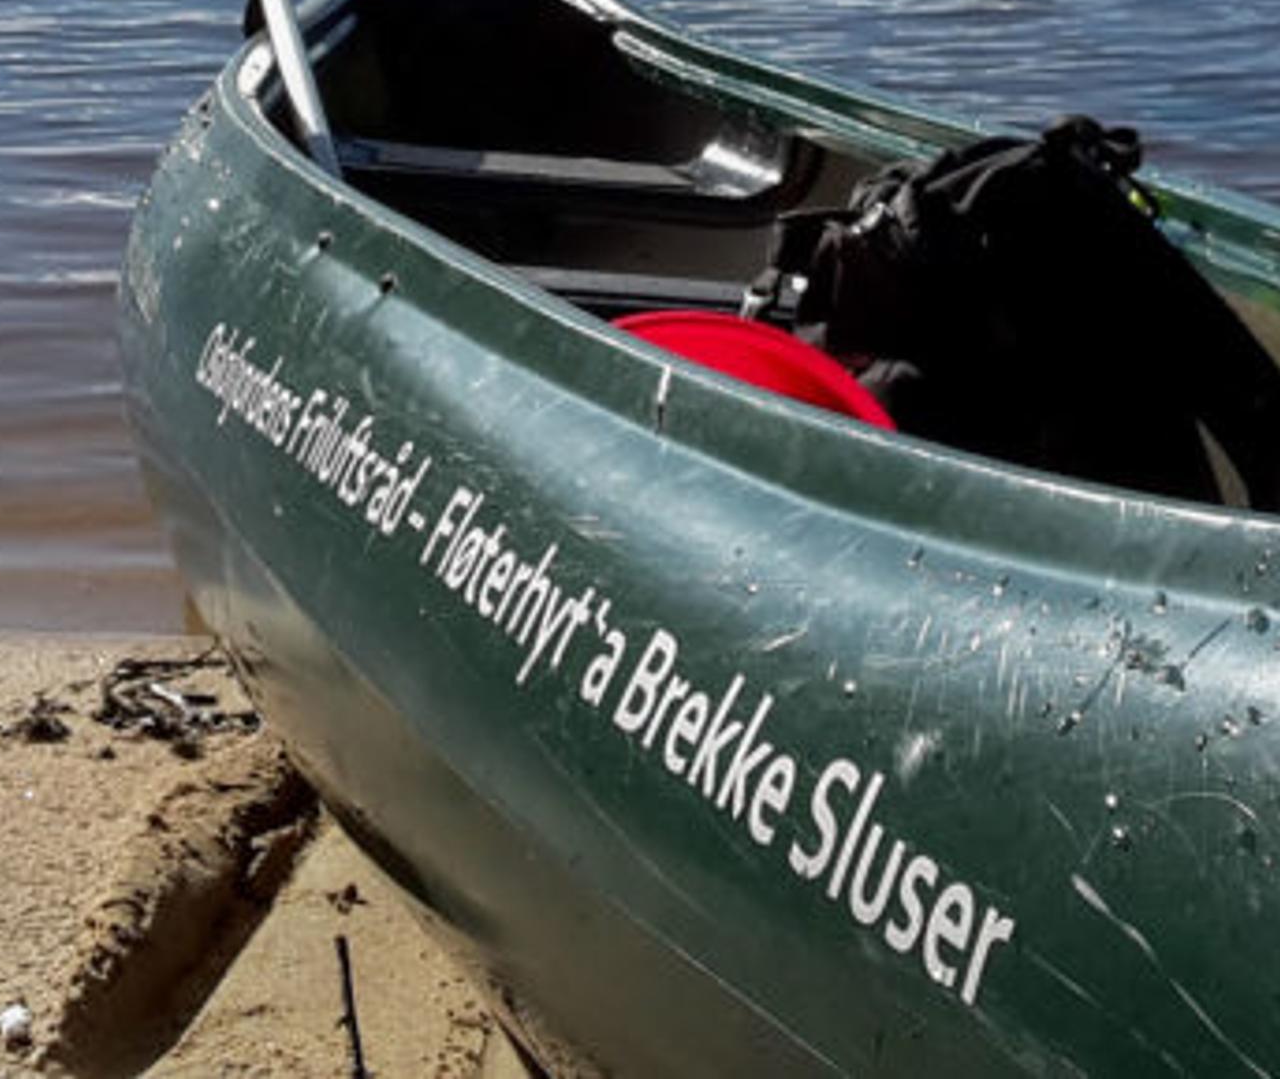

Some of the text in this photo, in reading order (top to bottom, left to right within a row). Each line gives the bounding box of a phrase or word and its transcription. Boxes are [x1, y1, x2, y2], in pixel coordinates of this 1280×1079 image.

[285, 388, 431, 535] Friluftsråd
[407, 510, 426, 532] -
[613, 628, 796, 846] Brekke
[788, 757, 1015, 1007] Sluser
